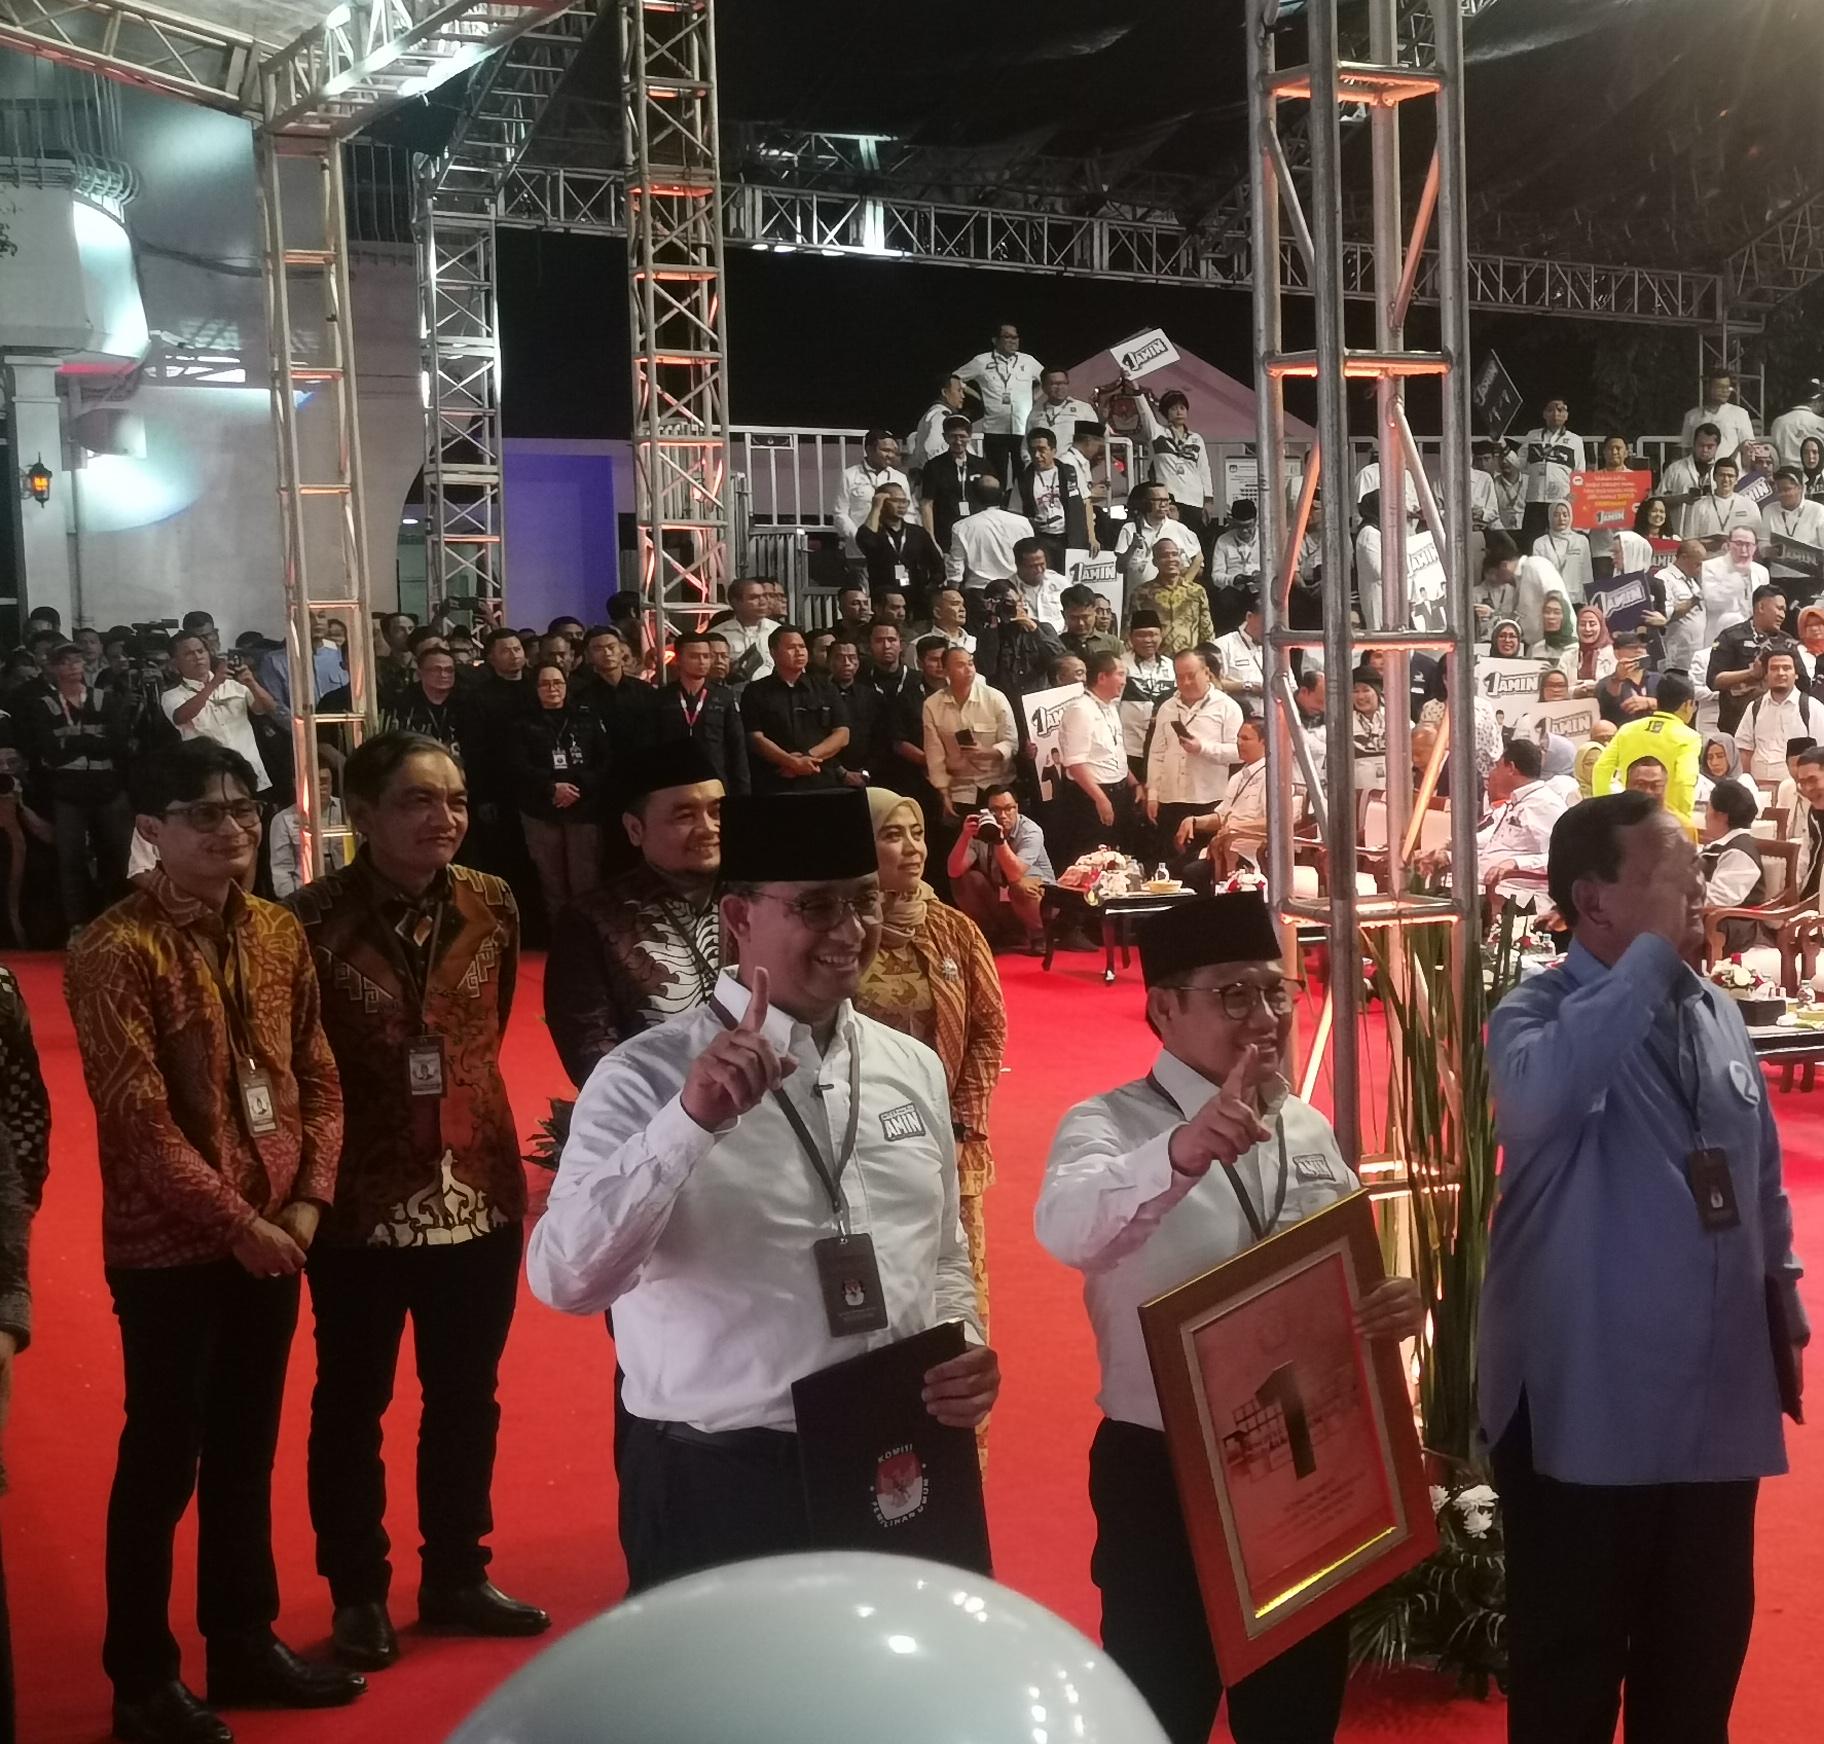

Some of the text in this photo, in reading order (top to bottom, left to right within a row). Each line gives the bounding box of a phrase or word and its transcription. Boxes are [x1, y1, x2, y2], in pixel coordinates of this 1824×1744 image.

[1733, 1064, 1759, 1103] 2
[883, 1111, 923, 1138] AMIN
[1254, 1360, 1317, 1481] 1
